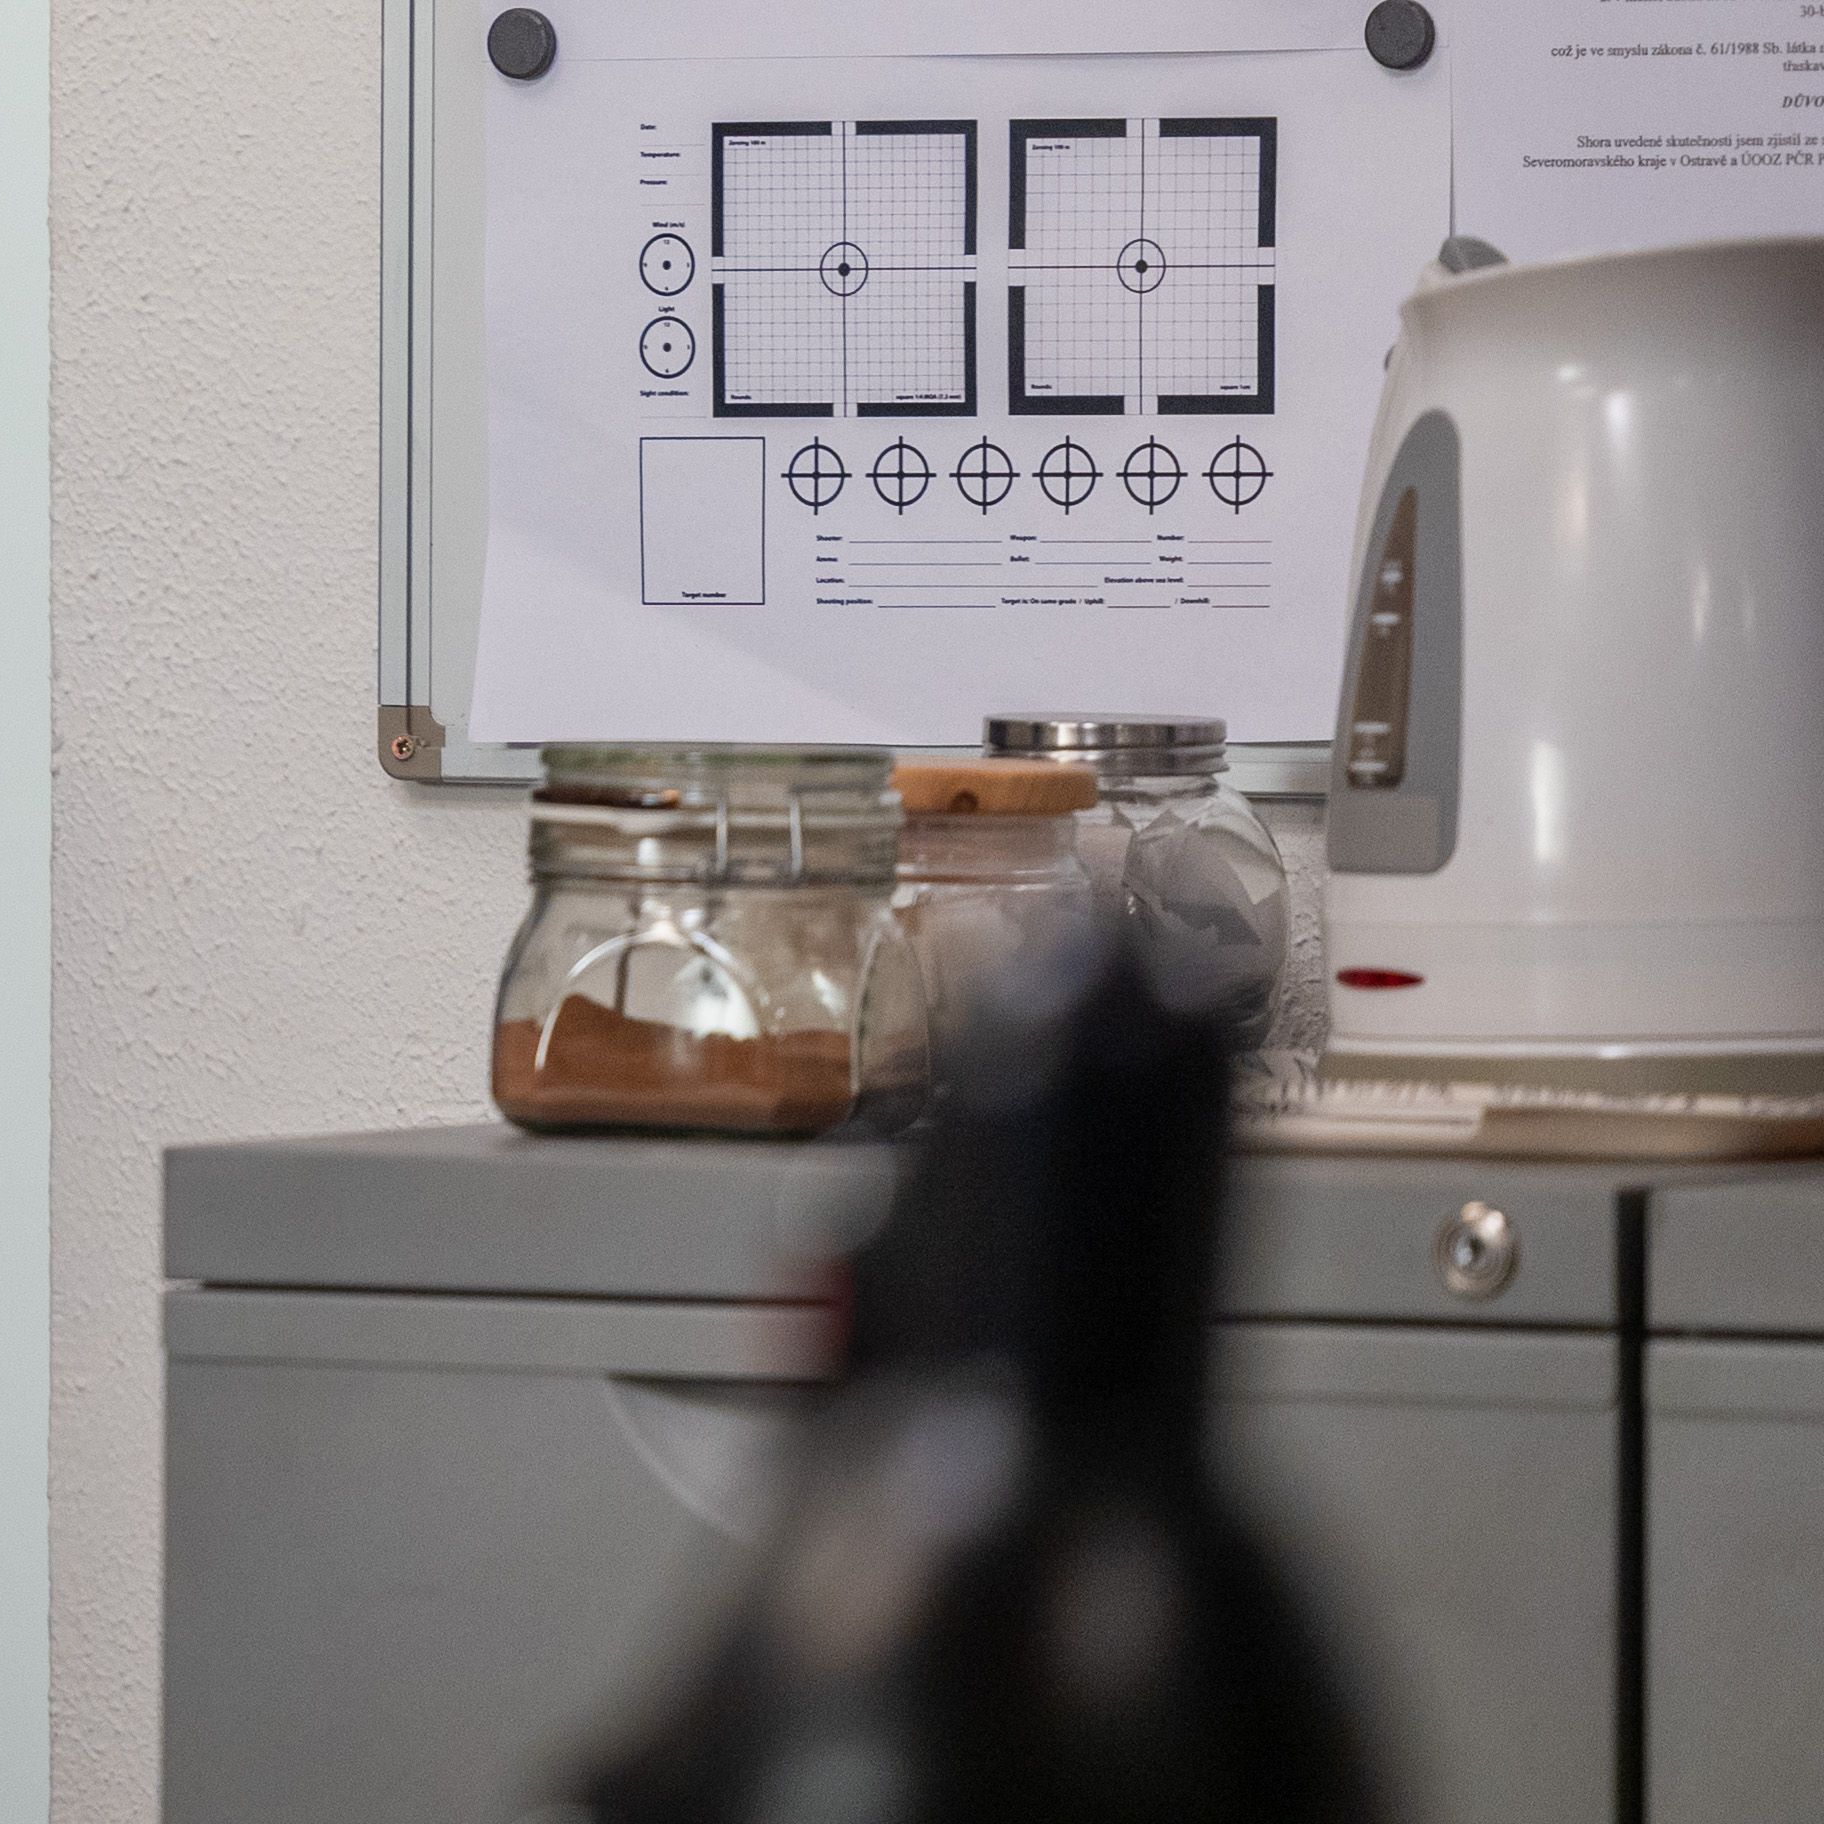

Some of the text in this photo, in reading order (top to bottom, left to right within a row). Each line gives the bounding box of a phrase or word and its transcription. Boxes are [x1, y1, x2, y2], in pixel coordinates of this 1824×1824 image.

[1551, 44, 1572, 57] což
[1575, 43, 1587, 60] je
[1607, 44, 1648, 59] smyslu
[1651, 43, 1692, 56] zákona
[1710, 42, 1760, 56] 61/1988
[1786, 41, 1816, 54] látka
[1577, 135, 1611, 148] Shora
[1614, 134, 1663, 148] uvedené
[1666, 134, 1732, 147] skutečnosti
[1735, 133, 1763, 149] jsem
[1767, 132, 1801, 148] zjistil
[1523, 155, 1635, 168] Severomoravského
[1638, 154, 1667, 170] kraje
[1680, 154, 1727, 167] Ostravě
[1741, 150, 1783, 166] ÚOOZ
[1786, 150, 1814, 166] PČR
